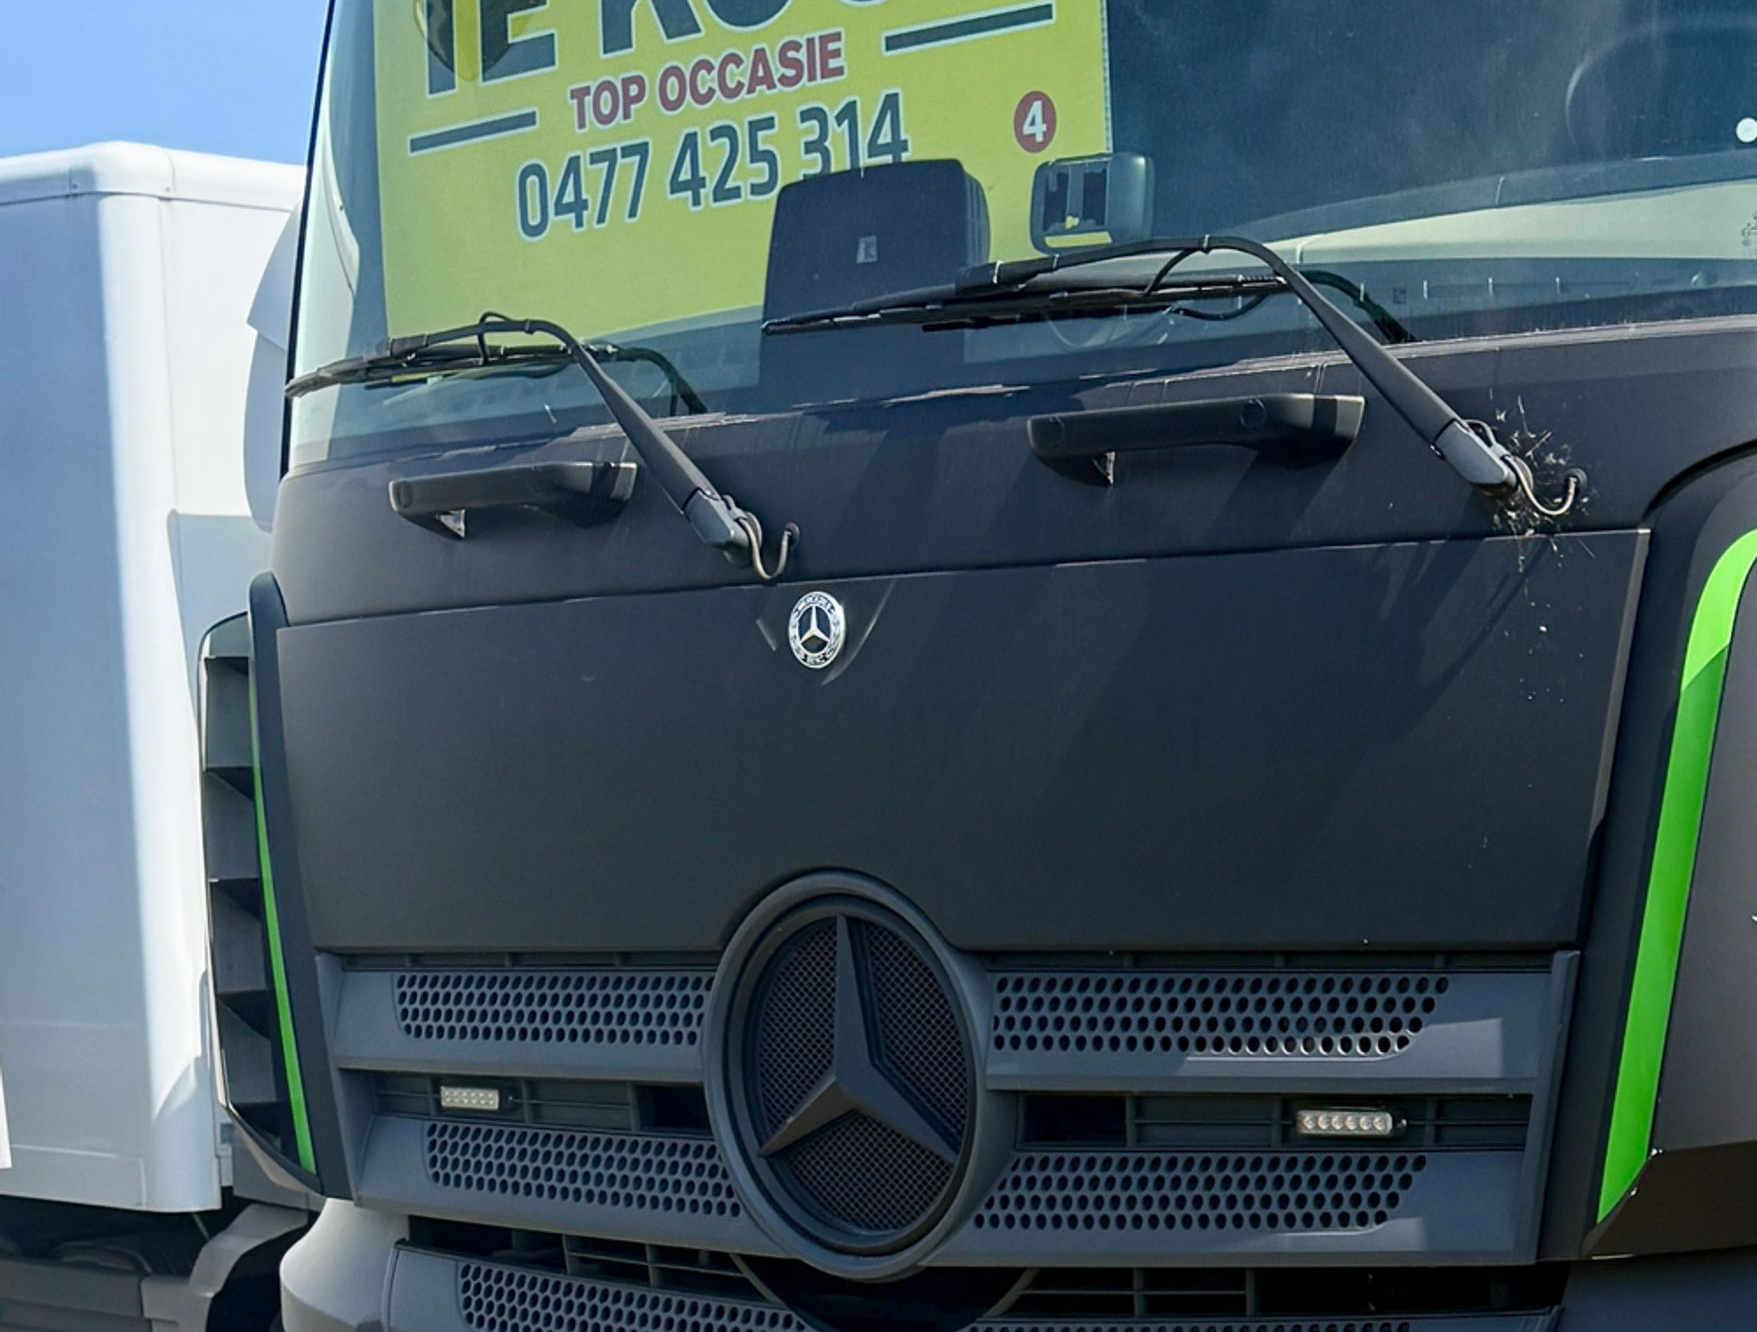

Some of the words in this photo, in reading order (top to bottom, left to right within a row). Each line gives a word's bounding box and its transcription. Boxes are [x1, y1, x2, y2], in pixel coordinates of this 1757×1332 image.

[569, 73, 647, 133] TOP
[657, 30, 846, 114] OCCASIE
[1022, 99, 1048, 144] 4
[516, 139, 651, 240] 0477
[667, 115, 781, 212] 425
[798, 92, 910, 180] 314
